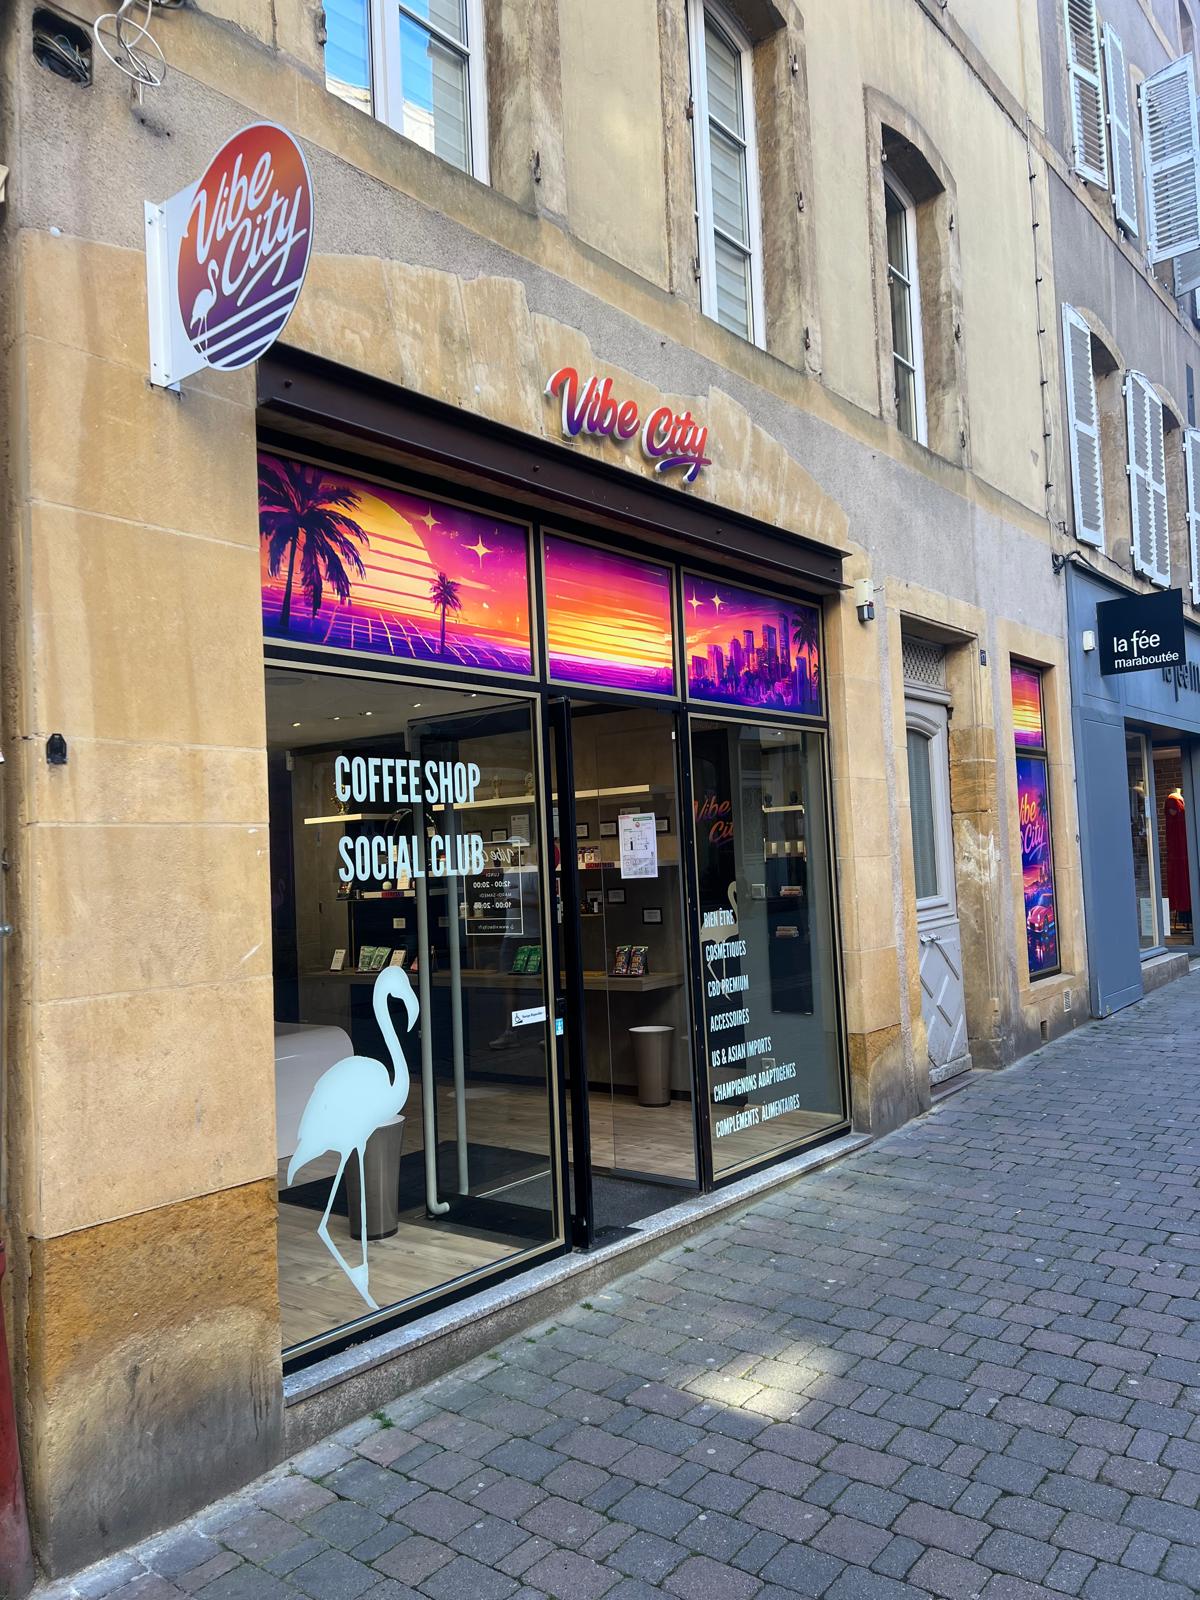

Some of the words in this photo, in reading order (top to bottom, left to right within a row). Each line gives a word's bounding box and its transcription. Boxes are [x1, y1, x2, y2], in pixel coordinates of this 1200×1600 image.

[185, 152, 273, 264] Vibe
[221, 185, 307, 306] City
[544, 367, 640, 440] Vibe
[642, 407, 712, 484] City
[1113, 637, 1128, 653] la
[1130, 629, 1161, 658] fée
[1114, 651, 1180, 669] maraboutée
[334, 755, 422, 803] COFFEE
[424, 760, 481, 804] SHOP
[709, 820, 734, 843] Cit
[1024, 820, 1047, 860] City
[338, 835, 425, 882] SOCIAL
[430, 834, 485, 876] CLUB
[704, 911, 719, 928] BIEN
[720, 907, 735, 926] ÊTRE
[705, 940, 747, 962] COSMÉTIQUES
[707, 981, 720, 998] CBD
[721, 975, 749, 995] PREMIUM
[710, 1007, 750, 1033] ACCESSOIRES
[711, 1049, 721, 1068] US
[721, 1048, 727, 1065] &
[728, 1042, 746, 1063] ASIAN
[746, 1036, 772, 1058] IMPORTS
[713, 1073, 758, 1103] CHAMPIGNONS
[758, 1062, 797, 1089] ADAPTOGÈNES
[715, 1110, 760, 1139] COMPLÉMENTS
